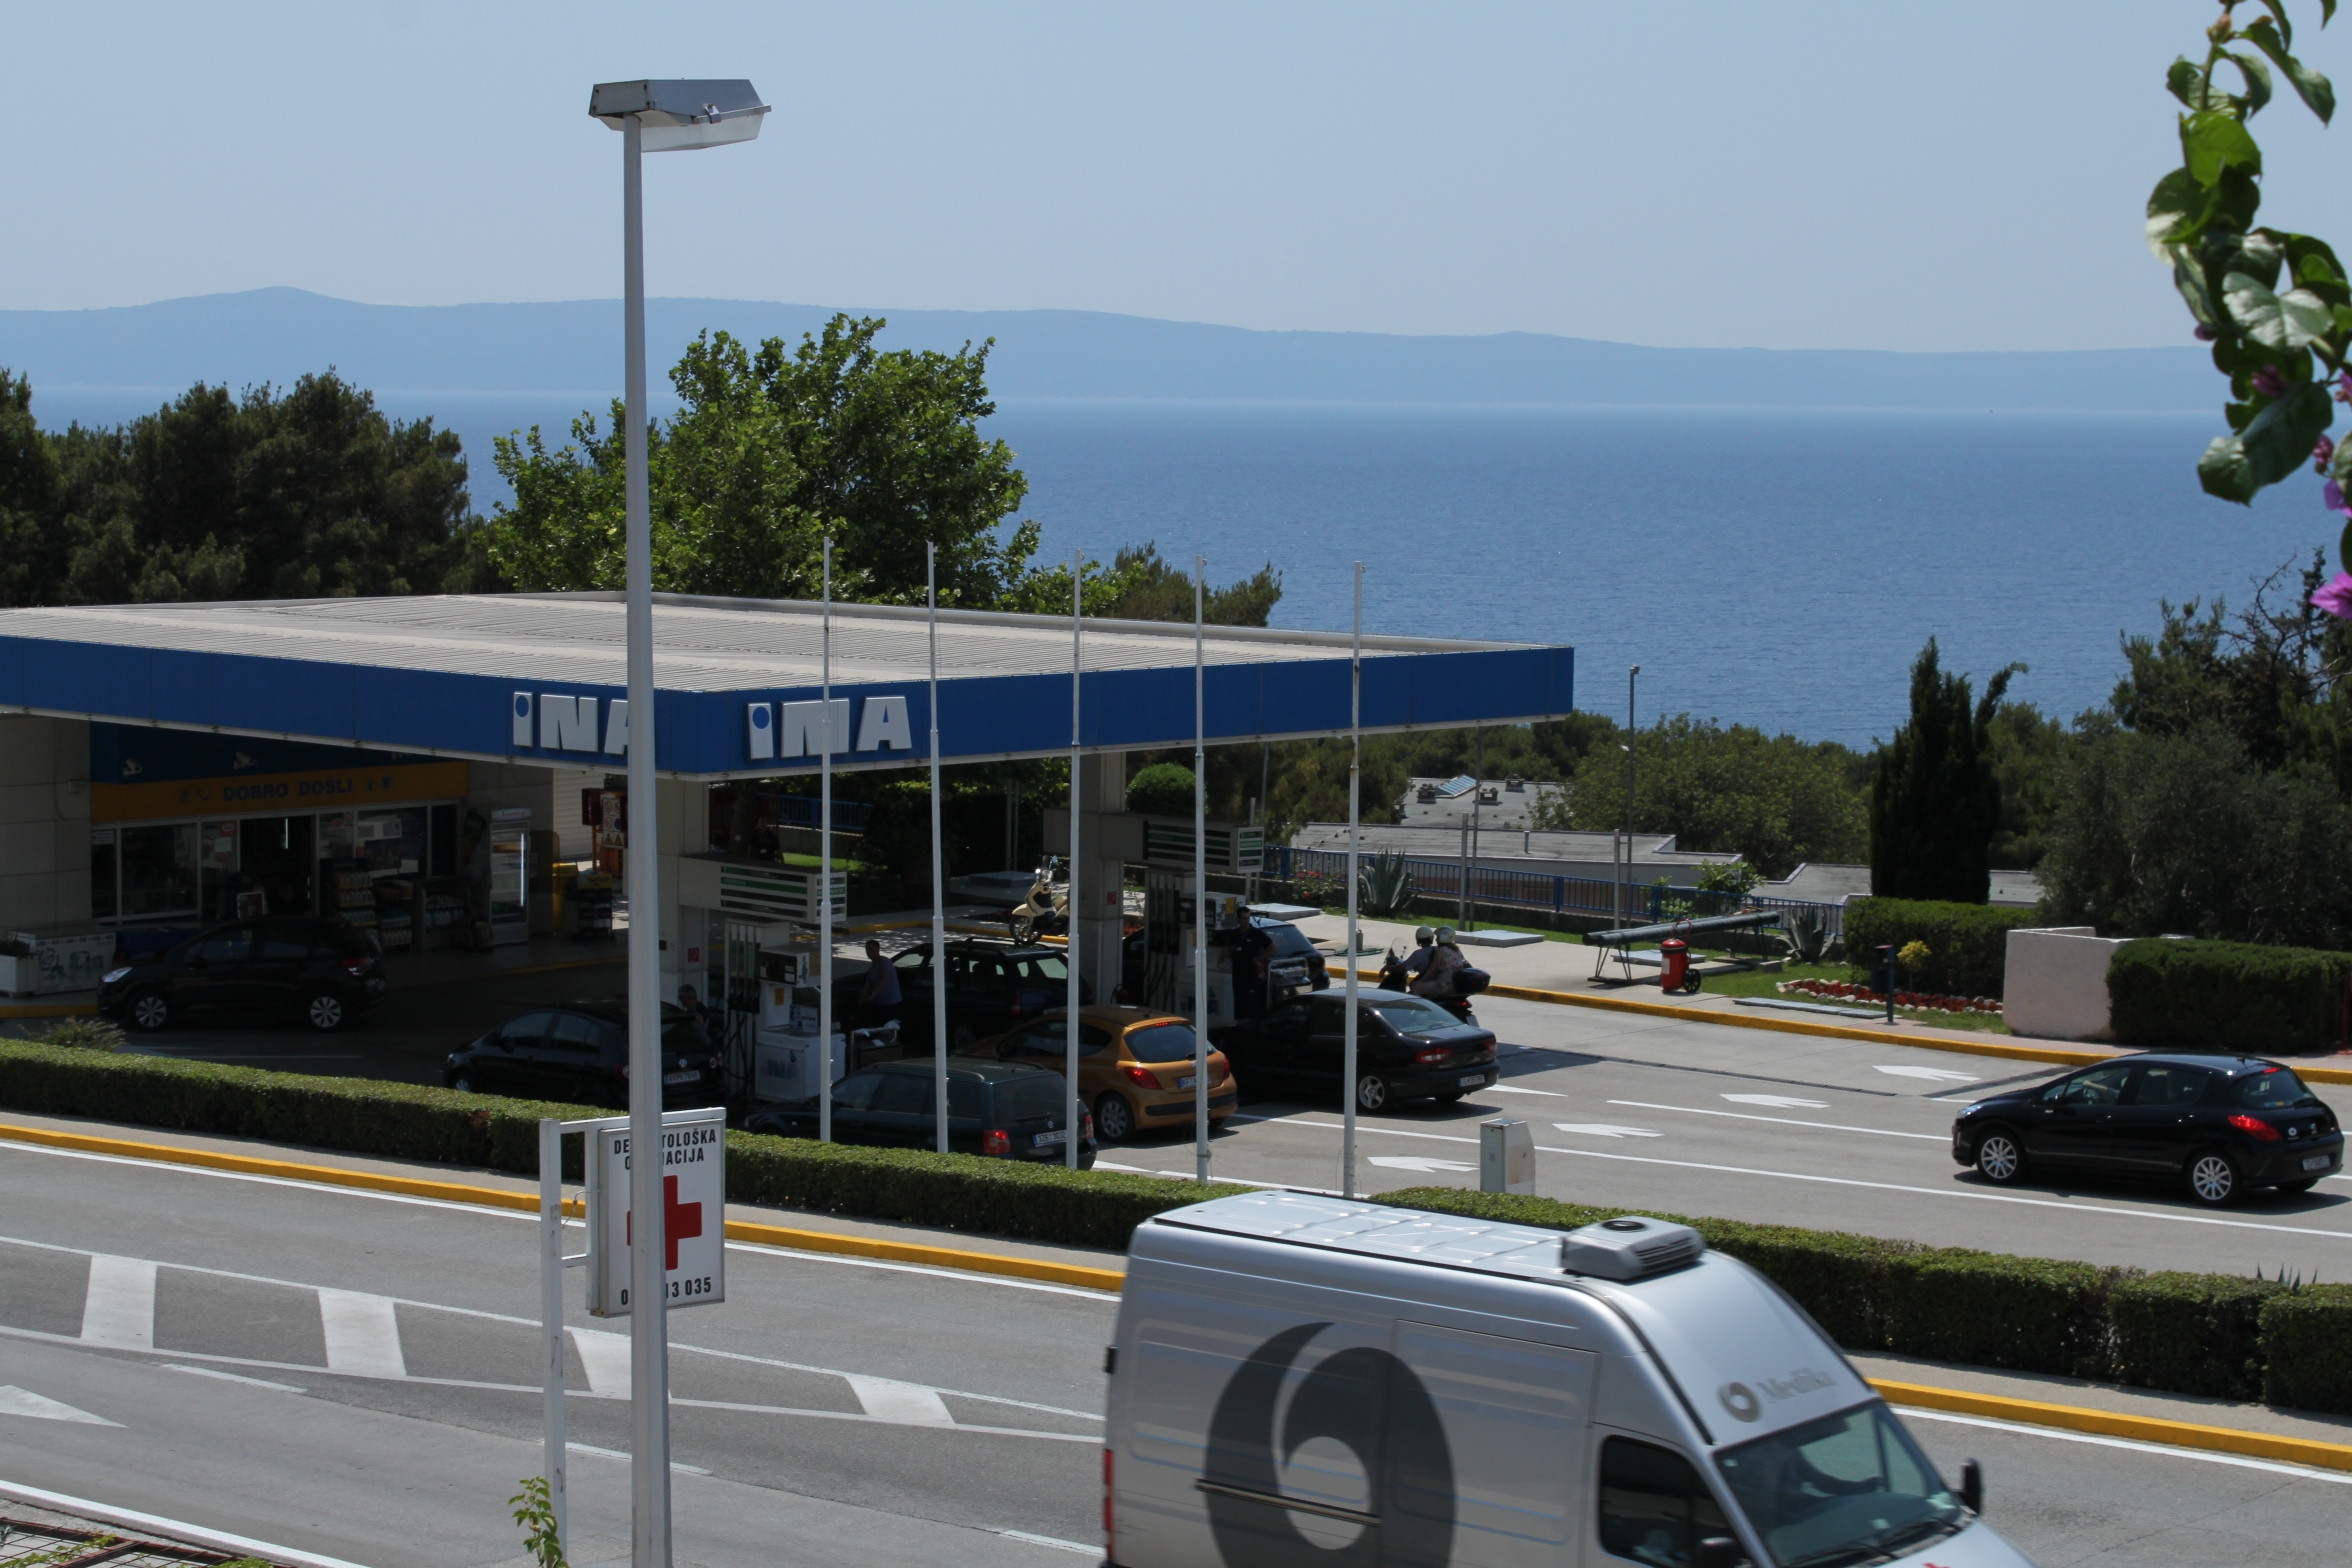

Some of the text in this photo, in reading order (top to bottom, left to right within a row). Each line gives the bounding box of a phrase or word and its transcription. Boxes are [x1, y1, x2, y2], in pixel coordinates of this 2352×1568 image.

[748, 696, 912, 760] INA
[223, 776, 354, 802] DOBRO DOŠLI
[614, 1128, 716, 1154] DETOLOŠKA
[685, 1276, 711, 1296] 035
